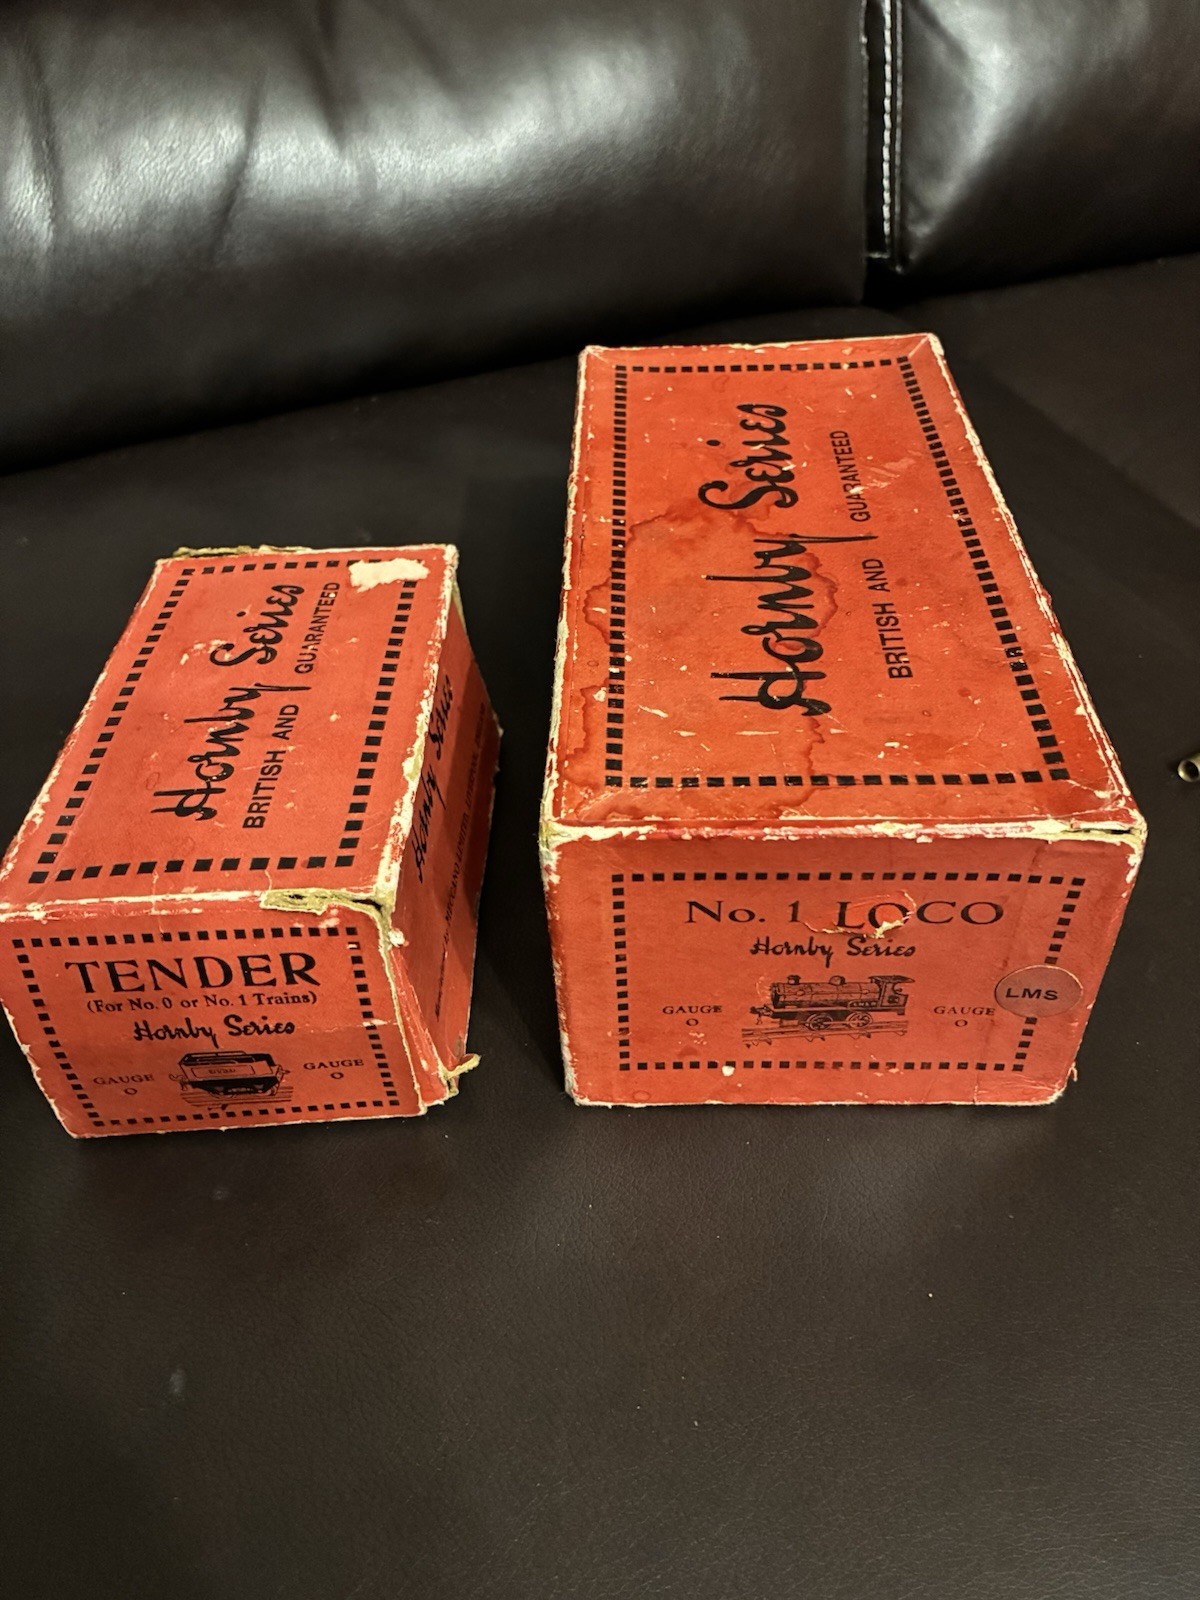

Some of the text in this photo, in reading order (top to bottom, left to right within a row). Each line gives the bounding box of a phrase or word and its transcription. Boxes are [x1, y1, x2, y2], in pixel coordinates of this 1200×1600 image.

[698, 403, 879, 716] Hornby Series
[830, 430, 913, 679] BRITISH AND GUARANTEED
[151, 584, 312, 821] Hornby Series
[242, 582, 341, 828] BRITISH AND GUARANTEED
[684, 899, 1004, 931] No. 1 LOCO
[750, 935, 916, 968] Hornby Series
[65, 952, 321, 994] TENDER
[86, 1000, 124, 1014] (For
[129, 1000, 160, 1012] No.
[180, 998, 199, 1009] or
[204, 994, 235, 1008] No.
[238, 995, 248, 1007] 1
[252, 990, 318, 1006] Trains)
[662, 1005, 723, 1015] GAUGE
[1005, 987, 1059, 1001] LMS
[933, 1006, 996, 1016] GAUGE
[133, 1013, 296, 1050] Hornby Series
[92, 1074, 155, 1086] GAUGE
[303, 1059, 365, 1071] GAUGE
